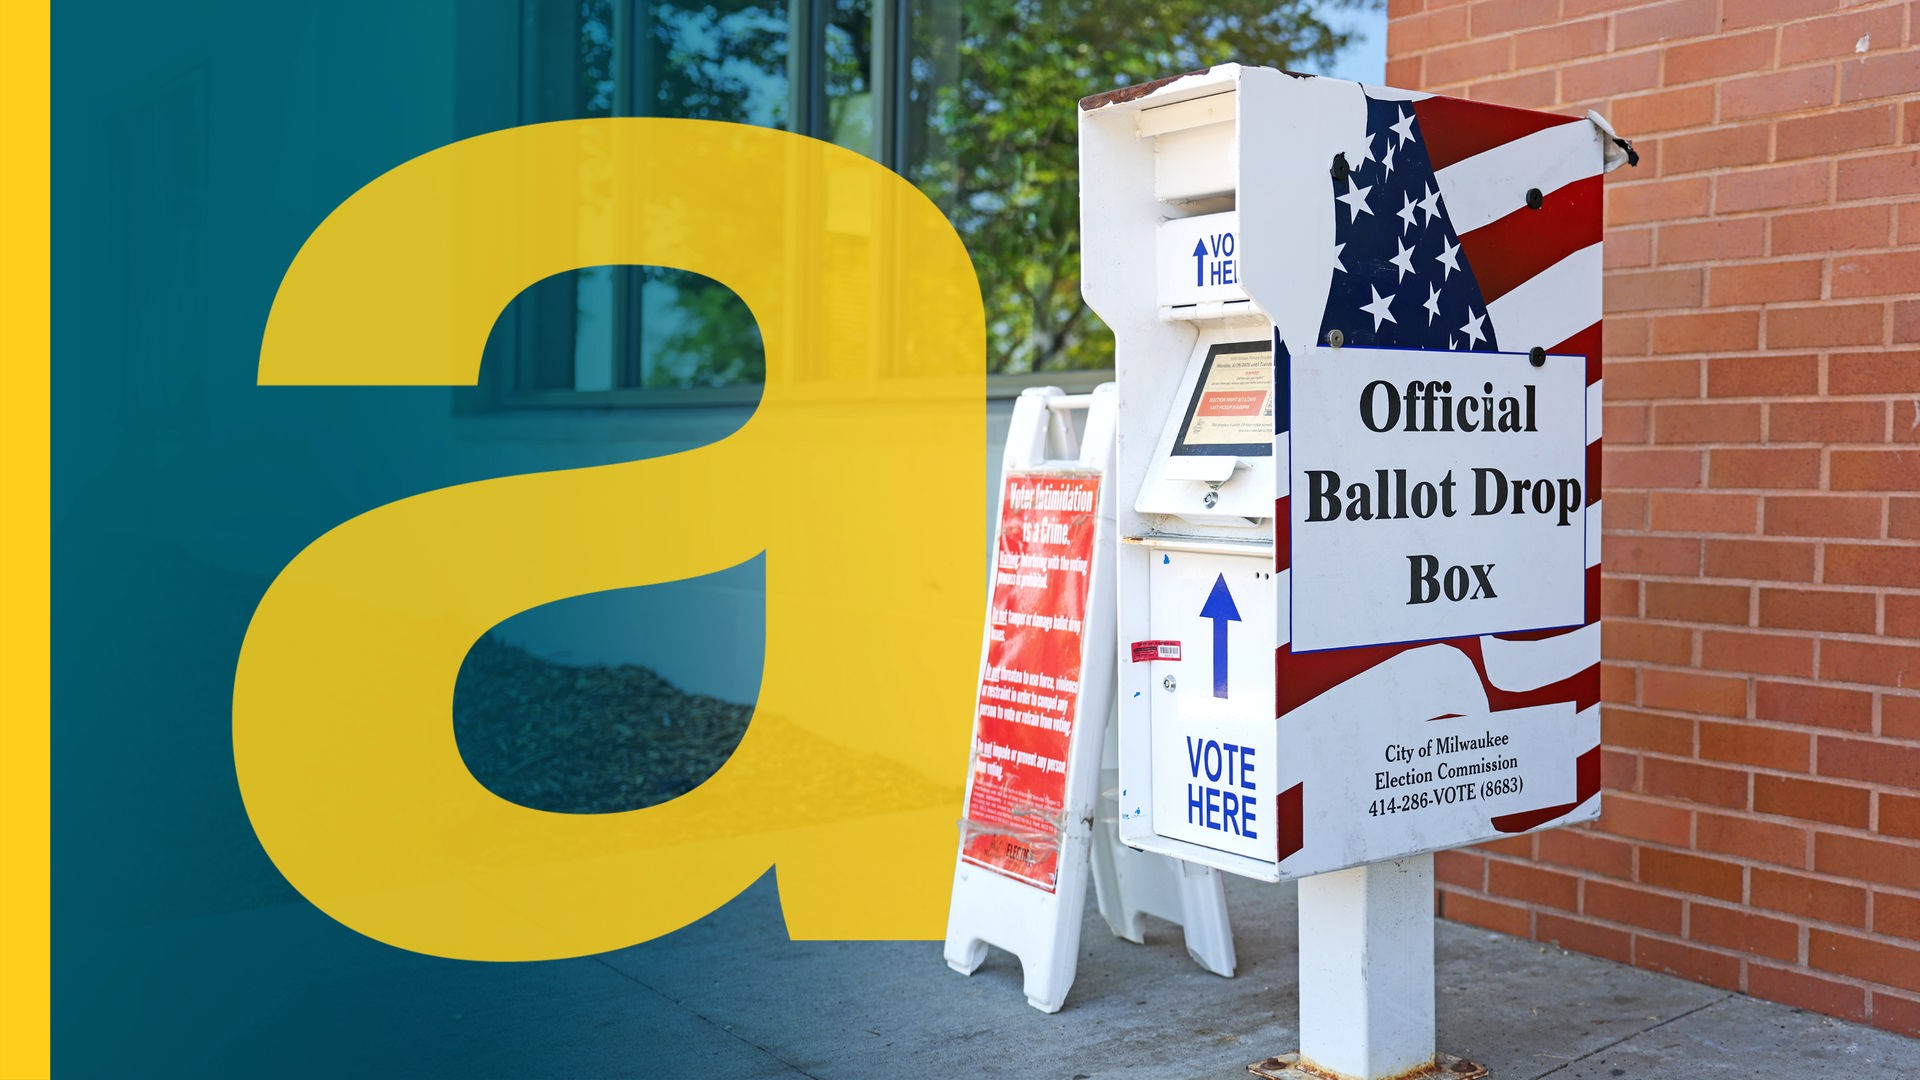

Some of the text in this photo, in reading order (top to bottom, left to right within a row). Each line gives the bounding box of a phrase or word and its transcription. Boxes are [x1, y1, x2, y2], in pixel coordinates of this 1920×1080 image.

[1210, 232, 1235, 258] VO
[1211, 260, 1238, 286] HE
[1359, 379, 1538, 433] Official
[1010, 483, 1093, 512] Voter Intimidation
[1303, 467, 1582, 526] Ballot Drop
[1023, 516, 1070, 545] is a Crime.
[1048, 554, 1060, 570] with
[1060, 554, 1069, 570] the
[1070, 556, 1088, 576] voting
[1406, 554, 1498, 605] Box
[1008, 609, 1026, 628] tamper
[1026, 614, 1032, 626] or
[1032, 612, 1053, 632] damage
[1053, 614, 1068, 630] ballot
[1068, 616, 1081, 636] drop
[1000, 666, 1023, 683] threaten
[1023, 670, 1029, 685] to
[1029, 673, 1039, 687] use
[1039, 672, 1054, 692] force,
[1056, 675, 1078, 693] violence
[981, 685, 1068, 715] or restraint in order to compel any
[980, 704, 1071, 737] person to vote or refrain from voting.
[992, 742, 1011, 761] impede
[1011, 749, 1017, 761] or
[1017, 751, 1037, 766] prevent
[1037, 755, 1047, 773] any
[1046, 758, 1066, 774] person
[1186, 735, 1257, 791] VOTE
[1385, 731, 1509, 764] City of Milwaukee
[1375, 754, 1518, 790] Election Commission
[1188, 783, 1257, 840] HERE
[1368, 775, 1524, 817] 414-286-VOTE (8683)
